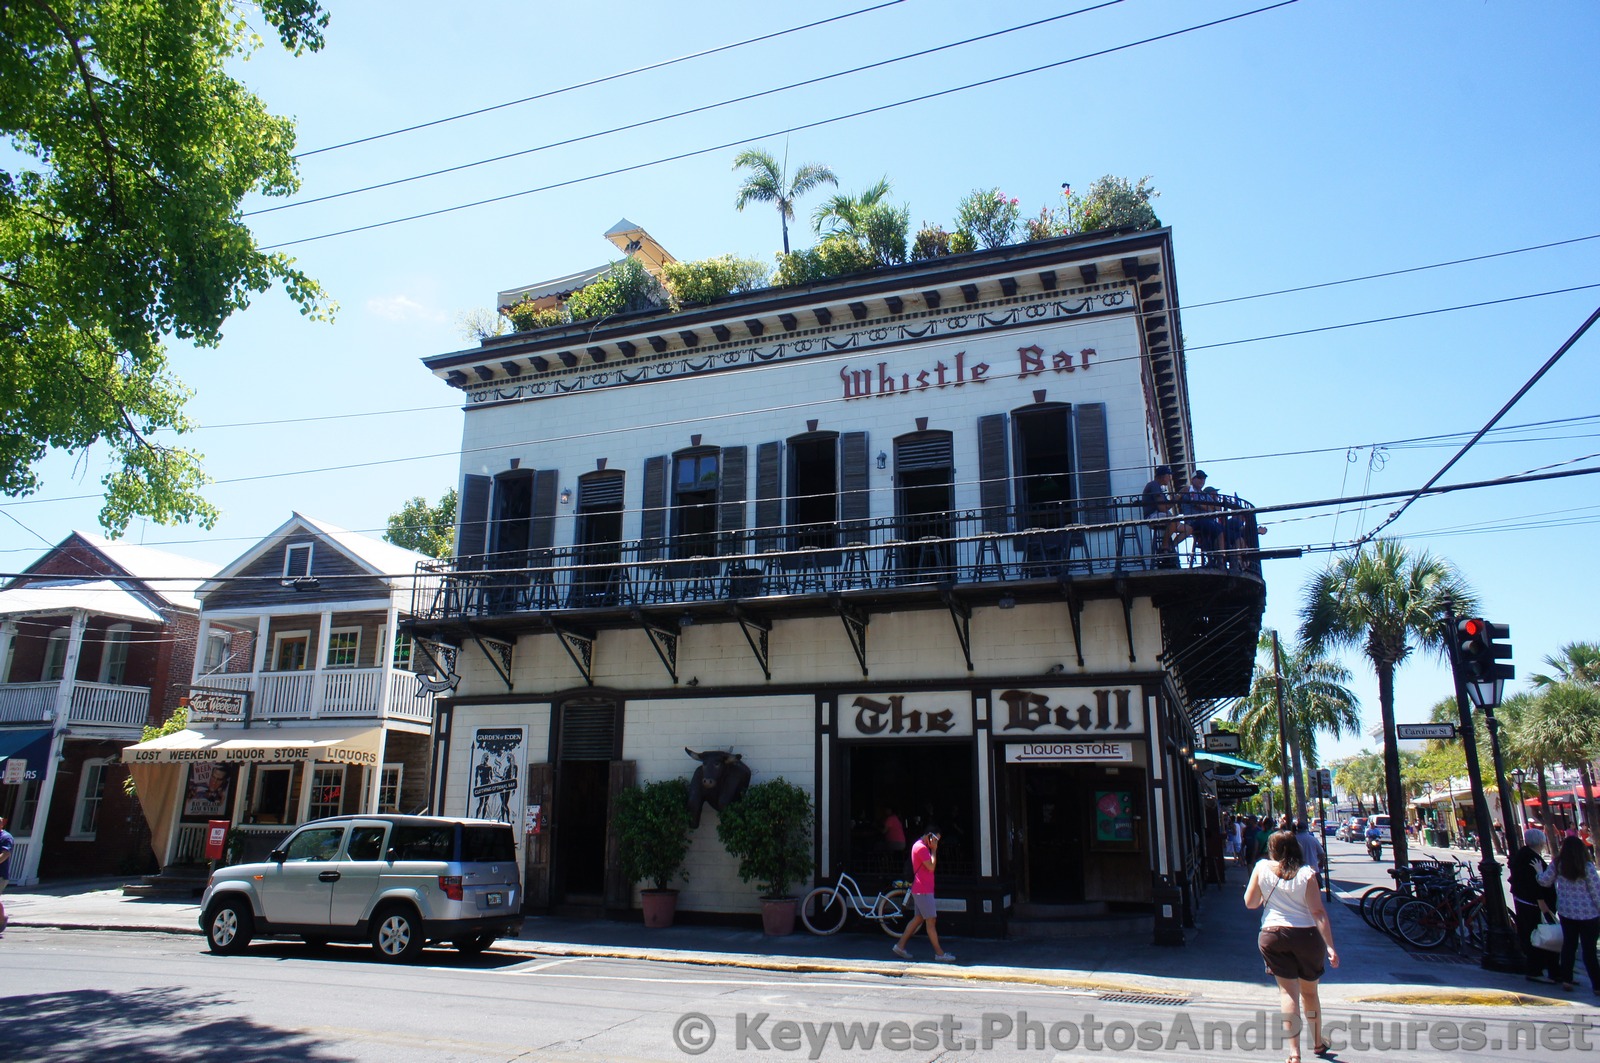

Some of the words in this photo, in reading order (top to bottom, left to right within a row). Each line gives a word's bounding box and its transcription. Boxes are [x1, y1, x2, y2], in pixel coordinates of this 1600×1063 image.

[839, 351, 990, 401] Whistle
[1016, 343, 1097, 380] Bar
[190, 695, 209, 712] Lost
[208, 696, 240, 714] Weekend
[851, 694, 956, 735] The
[999, 688, 1133, 732] Bull
[136, 751, 162, 760] LOST
[169, 750, 218, 760] WEEKEND
[226, 749, 265, 759] LIQUOR
[274, 748, 310, 758] STORE
[327, 748, 377, 763] LIQUORS
[1023, 744, 1073, 755] LIQUOR
[1075, 744, 1120, 754] STORE
